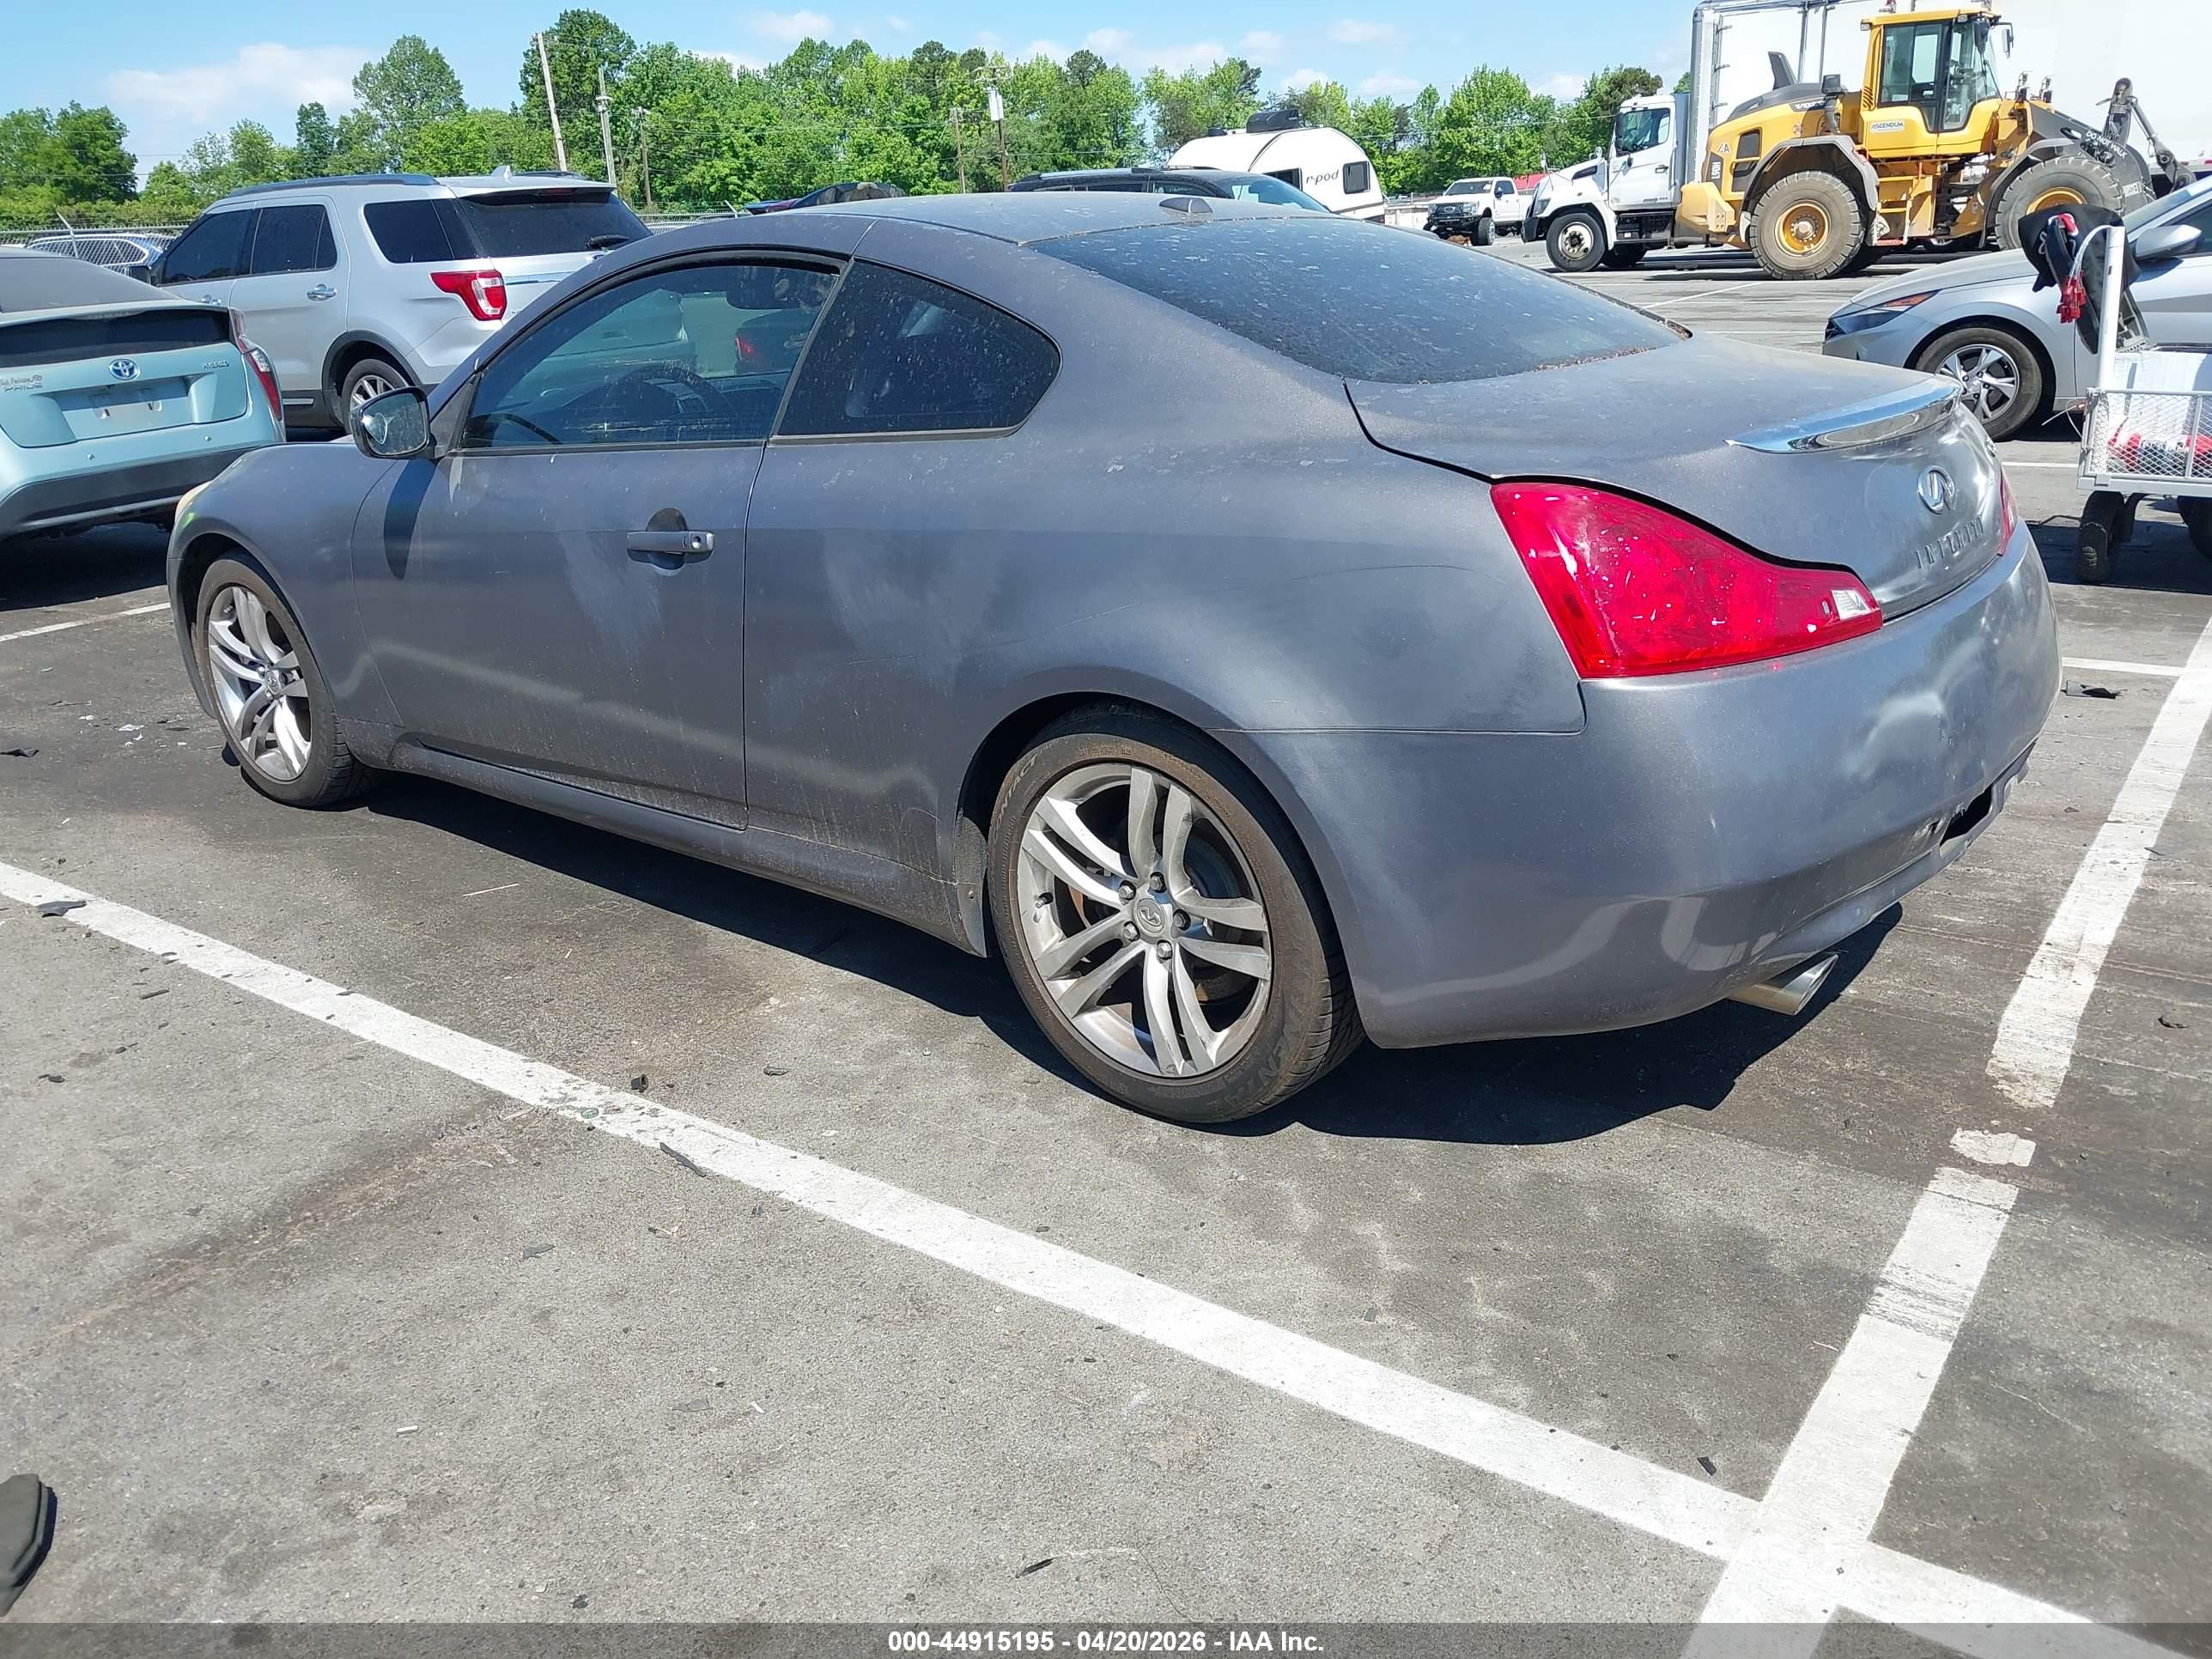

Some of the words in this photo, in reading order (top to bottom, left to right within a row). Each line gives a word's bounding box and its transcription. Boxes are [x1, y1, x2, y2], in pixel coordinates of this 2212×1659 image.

[2086, 131, 2097, 139] DO
[2097, 135, 2112, 146] NOT
[2110, 143, 2128, 159] WALK
